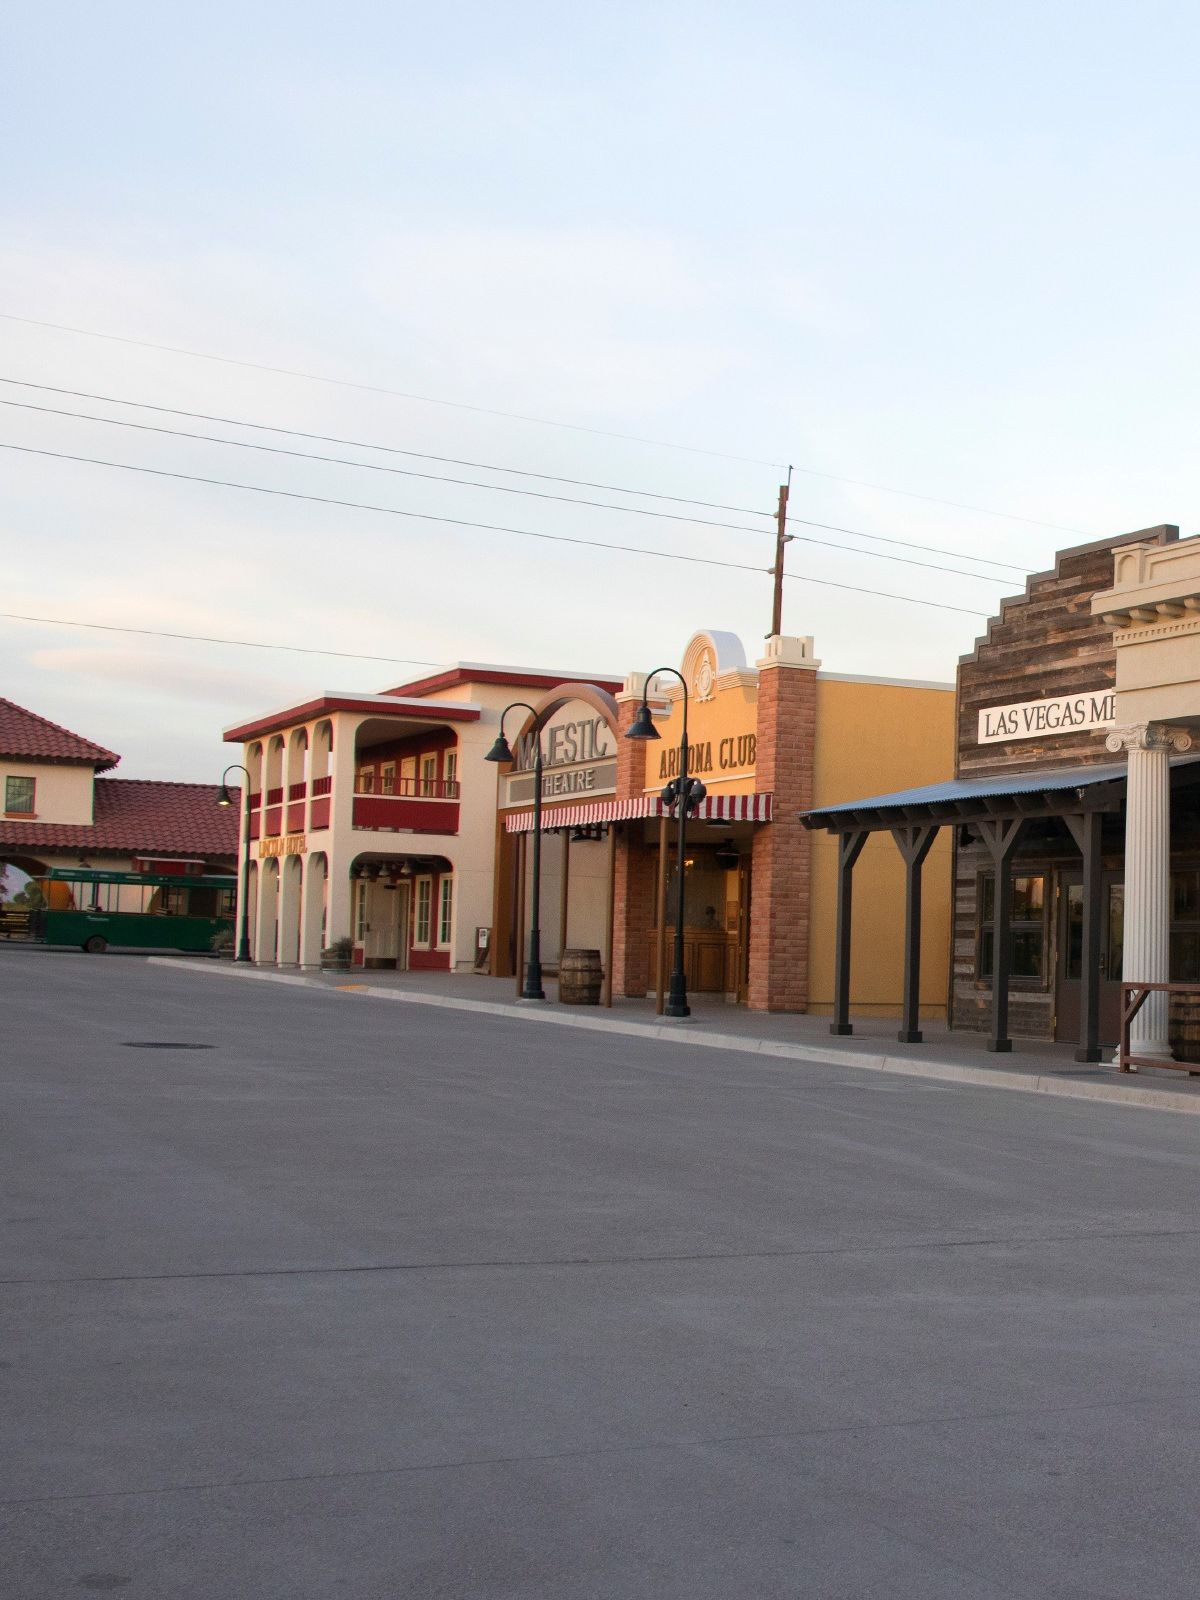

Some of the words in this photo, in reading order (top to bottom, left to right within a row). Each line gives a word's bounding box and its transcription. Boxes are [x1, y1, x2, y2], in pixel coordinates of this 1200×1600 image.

[985, 710, 1018, 738] LAS
[1022, 699, 1085, 732] VEGAS
[659, 742, 713, 779] ARIONA
[719, 733, 757, 770] CLUB
[259, 837, 285, 858] LINCOLN
[286, 834, 307, 855] HOTEL
